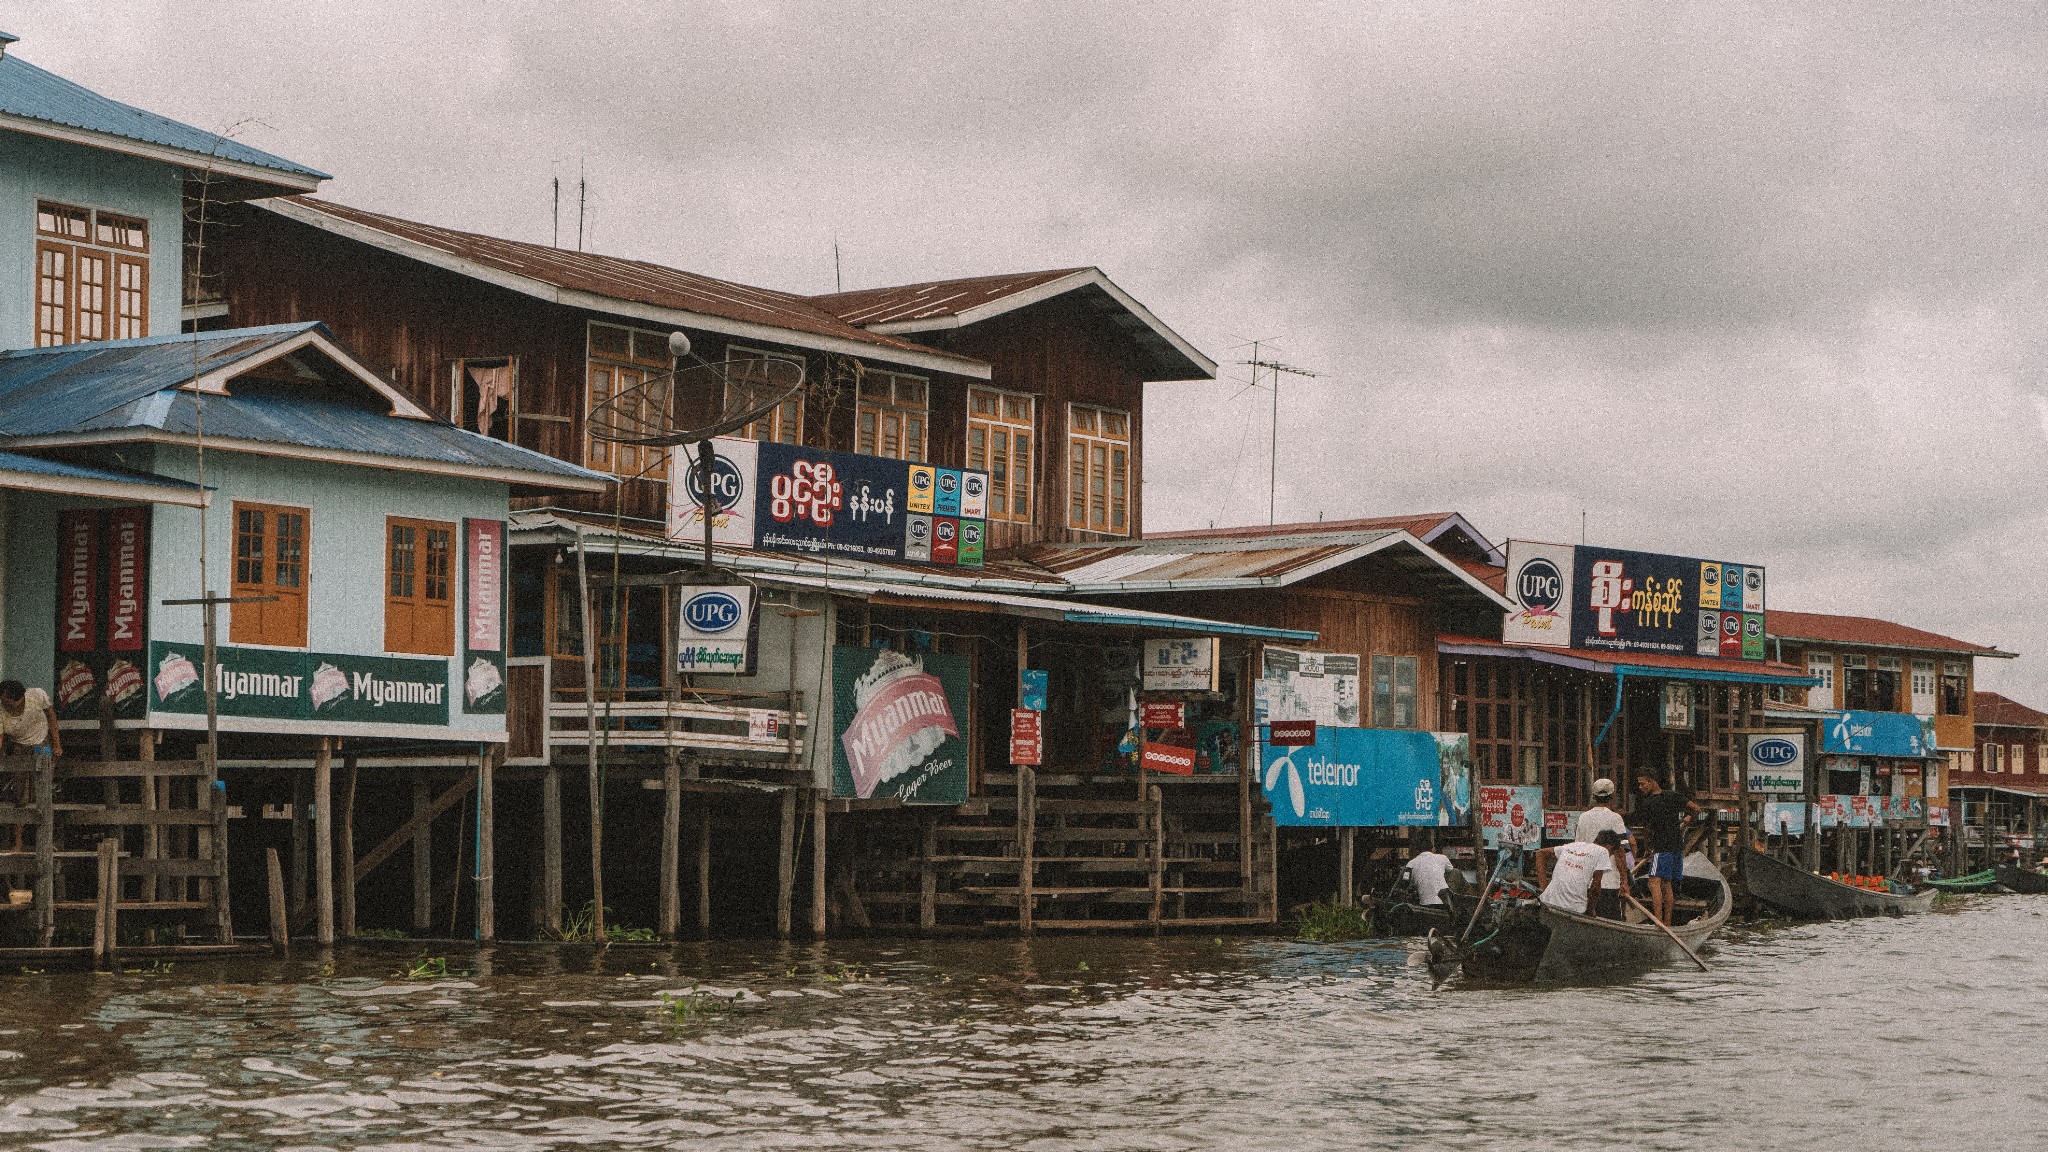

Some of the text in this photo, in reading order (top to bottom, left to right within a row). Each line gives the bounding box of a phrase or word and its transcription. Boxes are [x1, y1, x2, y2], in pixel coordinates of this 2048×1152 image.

[914, 474, 930, 485] UPG
[941, 477, 957, 489] UPG
[967, 481, 982, 492] UPG
[909, 501, 931, 511] UNITEX
[694, 509, 729, 529] Pint
[911, 525, 928, 535] UPG
[938, 528, 954, 537] UPG
[963, 530, 980, 540] UPG
[68, 522, 91, 641] Myanmar
[115, 521, 138, 640] Myanmar
[1704, 570, 1719, 581] UPG
[1725, 573, 1740, 583] UPG
[1746, 575, 1760, 586] UPG
[475, 528, 494, 641] Myanmar
[1523, 573, 1560, 600] UPG
[692, 603, 734, 622] UPG
[1702, 619, 1717, 630] UPG
[1725, 621, 1739, 631] UPG
[1746, 623, 1760, 633] UPG
[353, 671, 445, 707] Myanmar
[852, 690, 948, 777] Myanmar
[1758, 746, 1793, 760] UPG
[1145, 752, 1191, 767] ooredoo
[1308, 756, 1361, 787] telenor
[894, 759, 953, 803] Lager Beer
